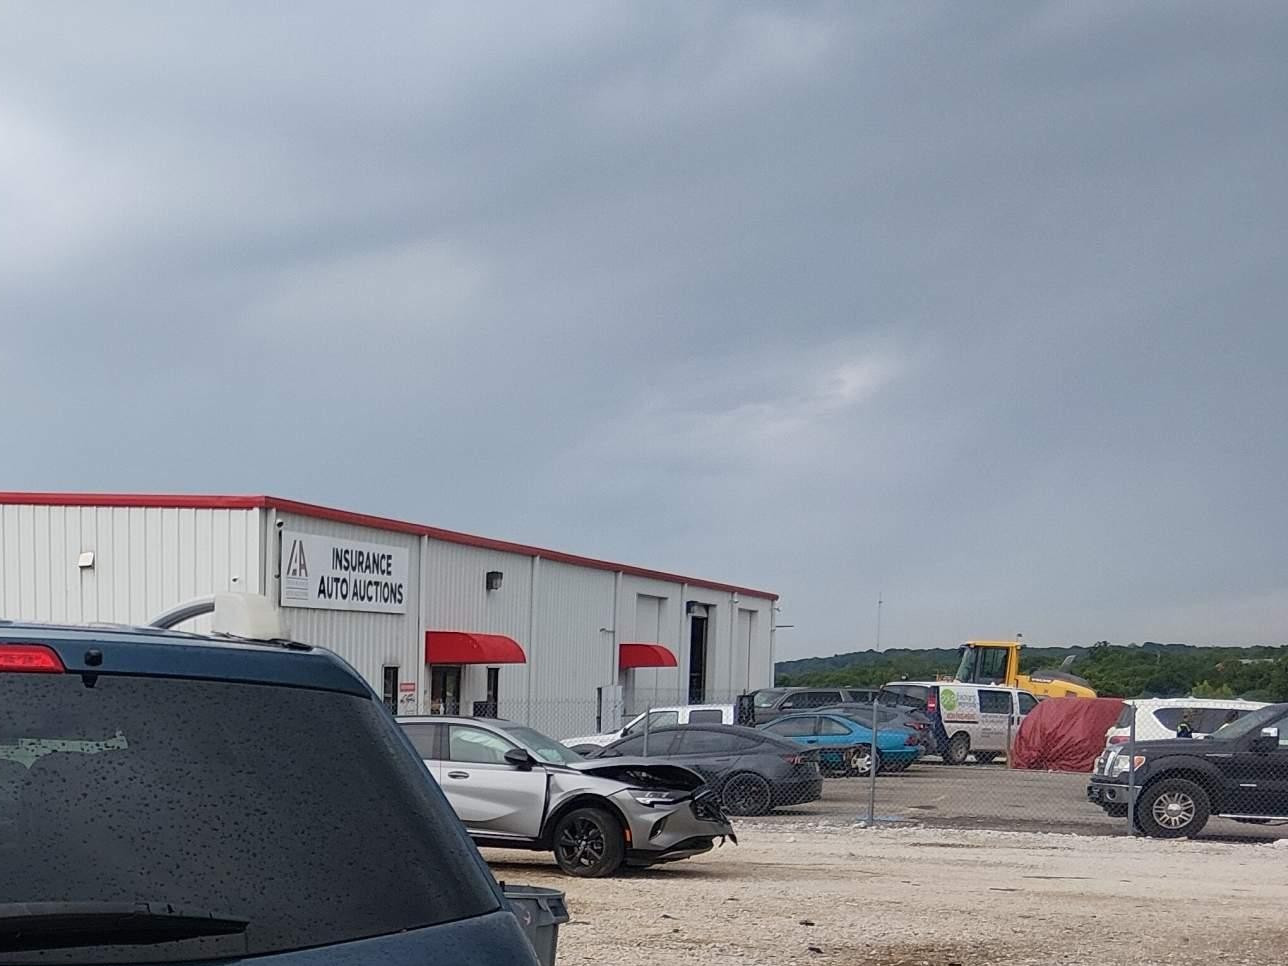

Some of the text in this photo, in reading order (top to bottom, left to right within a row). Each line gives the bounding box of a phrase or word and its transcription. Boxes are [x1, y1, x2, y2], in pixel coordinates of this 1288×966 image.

[332, 547, 393, 577] INSURANCE
[317, 575, 404, 605] AUTO AUCTIONS
